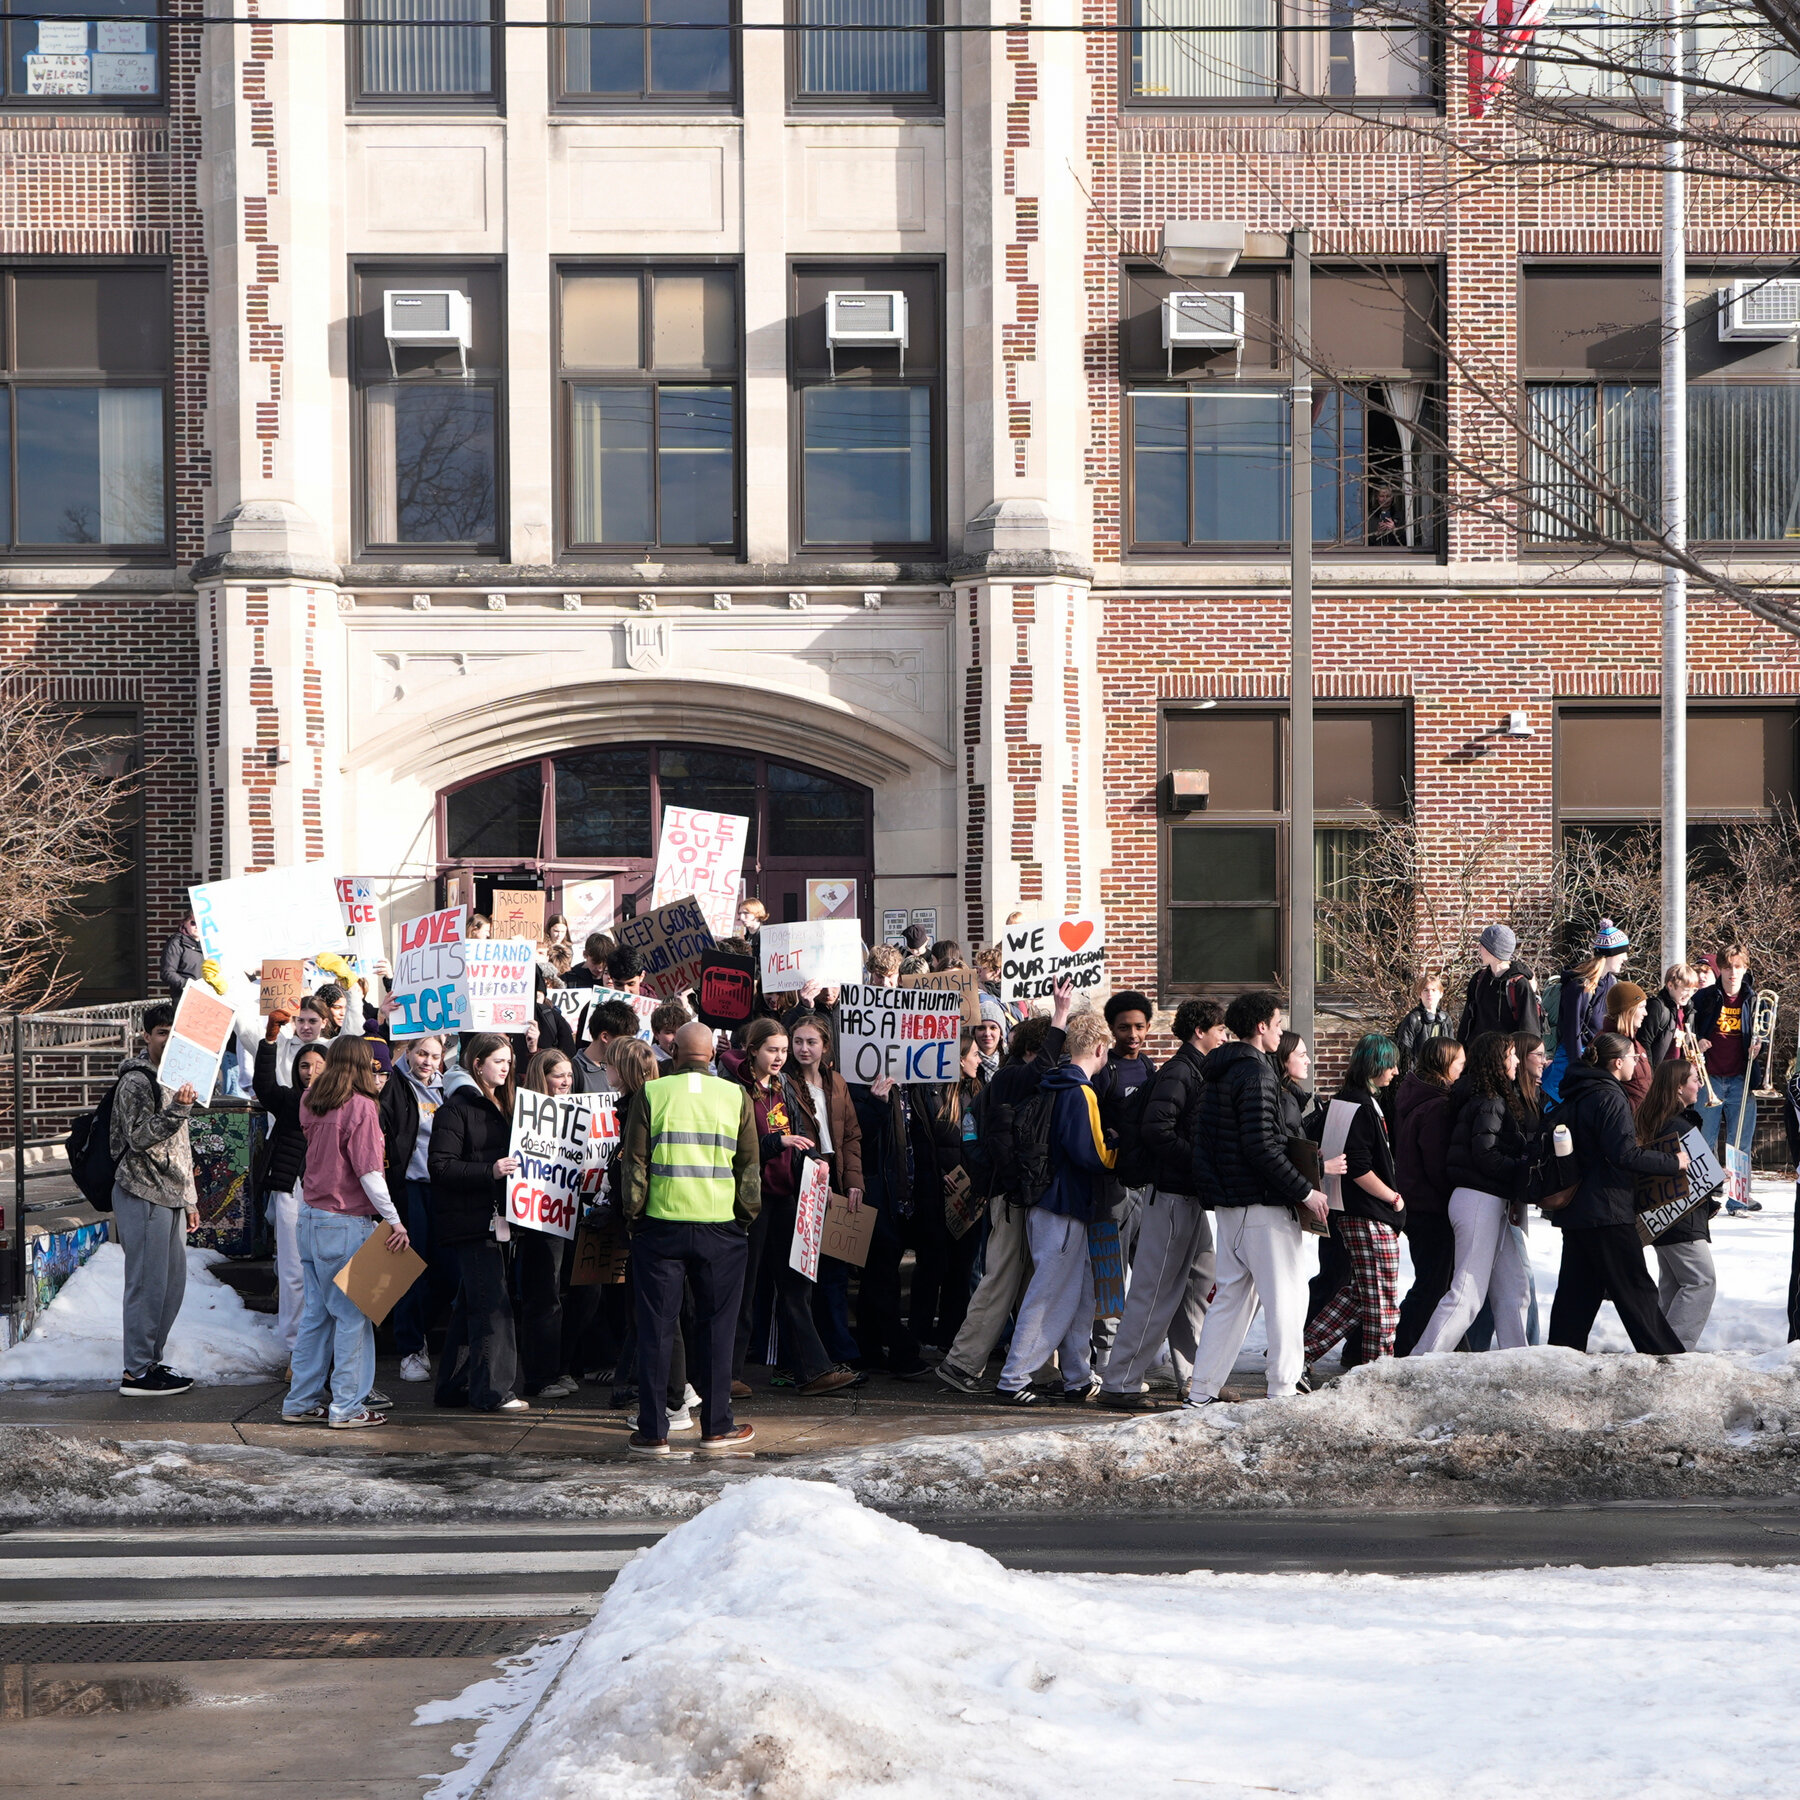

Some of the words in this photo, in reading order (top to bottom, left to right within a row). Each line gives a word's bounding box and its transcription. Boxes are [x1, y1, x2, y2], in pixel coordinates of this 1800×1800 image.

[30, 56, 49, 65] ALL
[55, 56, 76, 65] ARE
[32, 68, 89, 80] WELCOME
[43, 82, 74, 94] HERE
[669, 810, 737, 836] ICE
[668, 830, 734, 851] OUT
[678, 846, 722, 867] OF
[334, 878, 355, 903] KE
[657, 864, 740, 895] MPLS
[499, 891, 538, 906] RACISM
[657, 887, 735, 916] KRSTI
[348, 904, 376, 924] ICE
[401, 908, 461, 954] LOVE
[614, 917, 654, 948] KEEP
[1007, 927, 1044, 952] WE
[665, 929, 716, 964] FICTION
[261, 967, 291, 982] LOVE
[393, 942, 466, 990] MELTS
[492, 964, 525, 979] YOU
[768, 949, 803, 975] MELT
[1003, 957, 1044, 980] OUR
[261, 984, 294, 996] MELTS
[913, 973, 972, 991] ABOLISH
[262, 998, 287, 1009] ICE
[392, 983, 461, 1035] ICE
[841, 985, 859, 1006] NO
[864, 987, 917, 1010] DECENT
[918, 991, 960, 1011] HUMAN
[841, 1009, 876, 1037] HAS
[881, 1011, 896, 1039] A
[900, 1013, 960, 1040] HEART
[856, 1042, 900, 1082] OF
[905, 1041, 954, 1080] ICE
[519, 1093, 591, 1146] HATE
[521, 1131, 556, 1155] doesn't
[558, 1145, 584, 1165] make
[1658, 1175, 1687, 1202] ICE
[1728, 1171, 1748, 1204] ICE
[512, 1182, 576, 1232] Great
[796, 1190, 809, 1235] OUR
[1647, 1174, 1713, 1235] BORDERS
[832, 1205, 865, 1233] ICE
[808, 1240, 819, 1278] LIVE
[814, 1216, 822, 1235] IN
